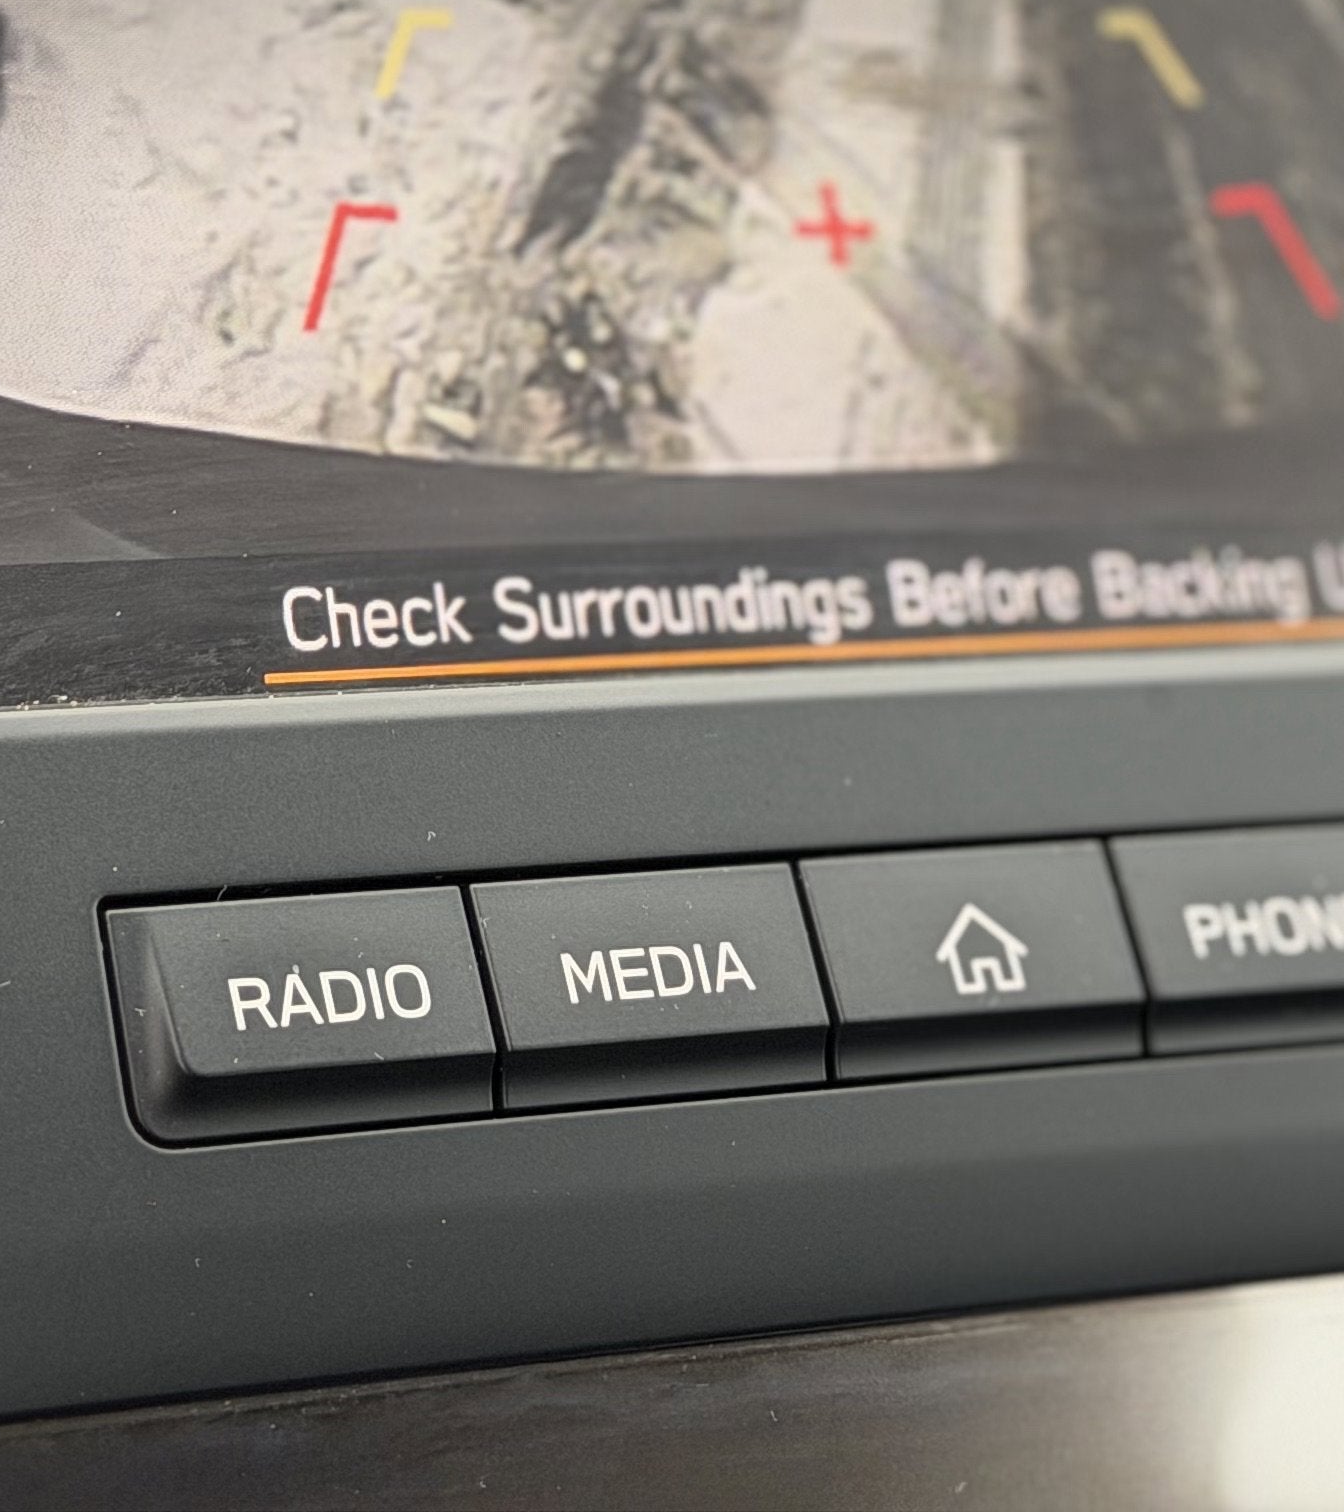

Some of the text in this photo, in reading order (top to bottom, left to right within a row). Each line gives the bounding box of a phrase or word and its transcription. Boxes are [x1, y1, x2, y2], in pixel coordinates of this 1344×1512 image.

[281, 581, 474, 653] Check
[493, 566, 873, 646] Surroundings
[885, 556, 1083, 627] Before
[1091, 544, 1312, 628] Backing
[227, 963, 433, 1032] RADIO
[559, 940, 757, 1005] MEDIA
